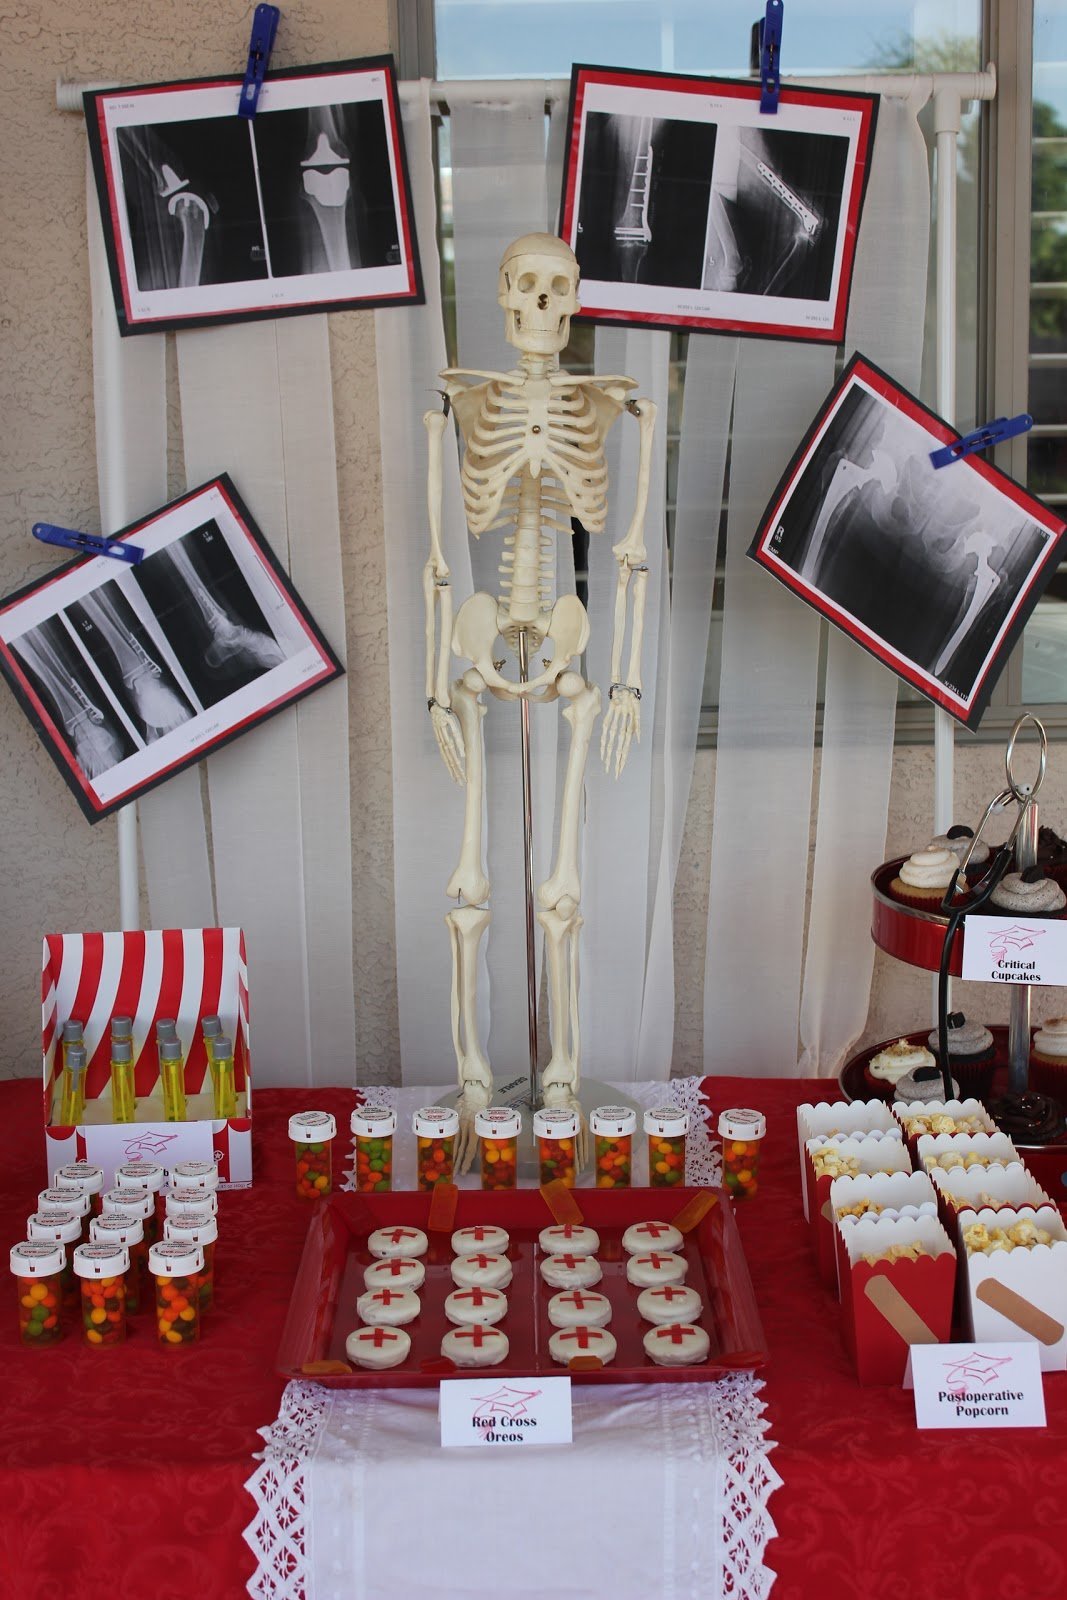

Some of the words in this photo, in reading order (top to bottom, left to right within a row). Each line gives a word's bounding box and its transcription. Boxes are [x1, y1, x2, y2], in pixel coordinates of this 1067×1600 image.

[776, 525, 785, 537] R
[997, 959, 1036, 970] Critical
[991, 970, 1041, 982] Cupcakes
[937, 1390, 1024, 1404] Postoperative
[956, 1405, 1009, 1418] Popcorn
[472, 1416, 496, 1428] Red
[500, 1415, 537, 1428] Cross
[486, 1431, 524, 1443] Oreos
